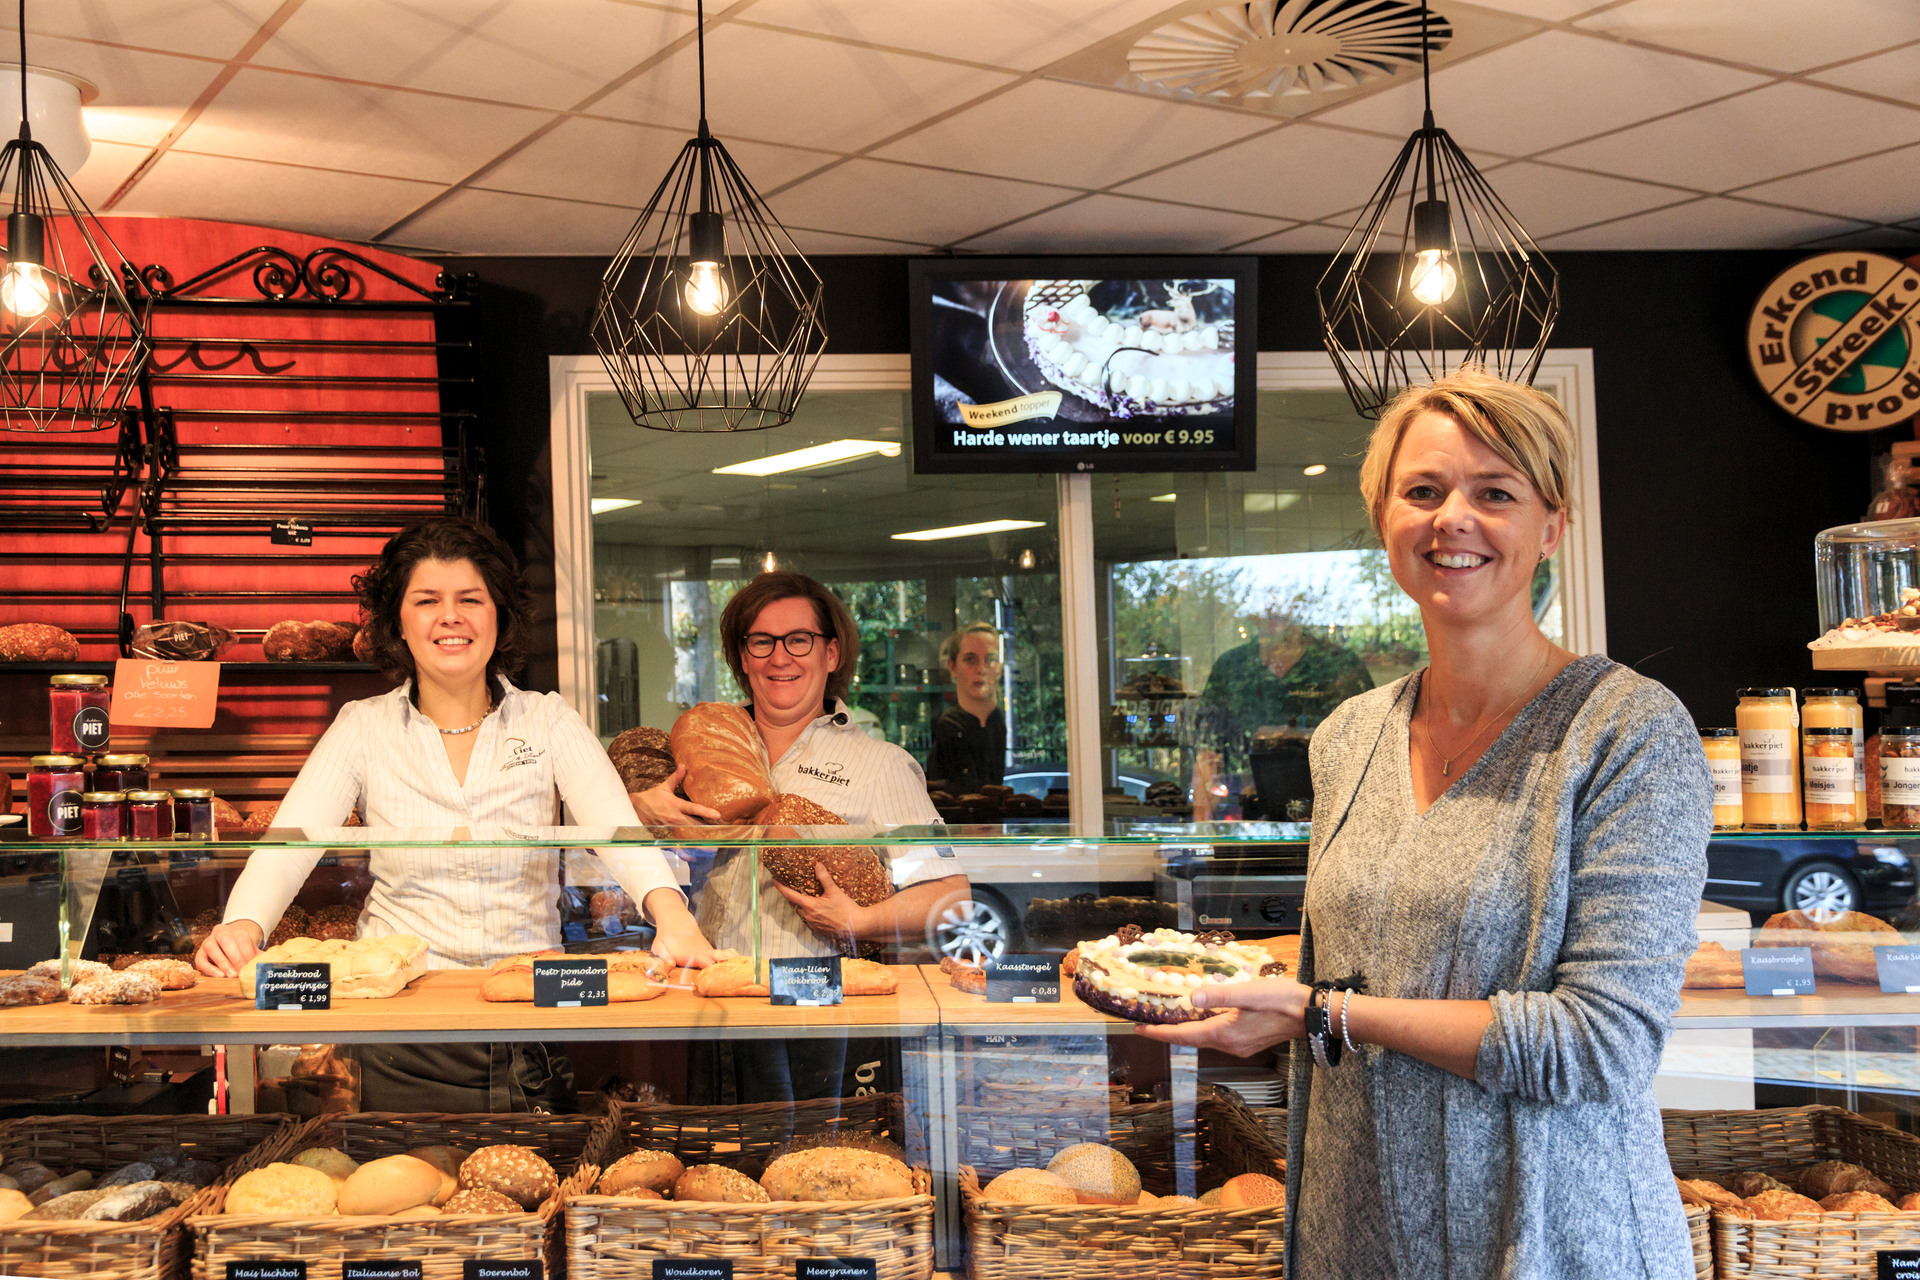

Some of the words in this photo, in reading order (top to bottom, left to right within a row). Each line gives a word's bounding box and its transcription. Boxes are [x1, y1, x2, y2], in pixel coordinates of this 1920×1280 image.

[1758, 260, 1868, 366] Erkend
[1794, 293, 1908, 396] Streek
[1825, 371, 1920, 425] prod
[969, 405, 1018, 420] Weekend
[1020, 400, 1050, 412] topper
[953, 430, 1005, 446] Harde
[1007, 433, 1060, 446] wener
[1063, 429, 1120, 449] taartje
[1122, 433, 1162, 445] voor
[1164, 430, 1175, 444] €
[1178, 430, 1215, 445] 9.95
[173, 632, 189, 643] PIET
[82, 722, 103, 736] PIET
[1743, 742, 1767, 750] bakker
[1769, 742, 1783, 751] piet
[1812, 765, 1835, 773] bakker
[797, 763, 830, 780] bakker
[829, 774, 851, 787] piet
[1809, 781, 1836, 791] Meisjes
[57, 806, 80, 820] PIET
[1751, 954, 1805, 965] Kaasbroodje
[1887, 953, 1909, 961] Kaas
[535, 967, 560, 977] Pesto
[560, 966, 608, 978] pomodoro
[782, 965, 831, 974] Kaas-Uien
[996, 962, 1052, 973] Kaasstengel
[267, 969, 321, 979] Breekbrood
[561, 978, 583, 989] pide
[785, 975, 830, 985] stokbrood
[1794, 979, 1812, 987] 1,95
[260, 981, 329, 992] rozemarijnzee
[1031, 987, 1037, 995] €
[1038, 987, 1057, 996] 0,89
[308, 994, 327, 1003] 1,99
[587, 990, 606, 999] 2,35
[234, 1269, 259, 1278] Mais
[260, 1268, 300, 1278] luchbol
[347, 1268, 401, 1278] Italiaanse
[402, 1268, 421, 1278] Bol
[478, 1267, 530, 1277] Boerenbol
[665, 1267, 723, 1276] Woudkoren
[806, 1266, 868, 1277] Meergranen
